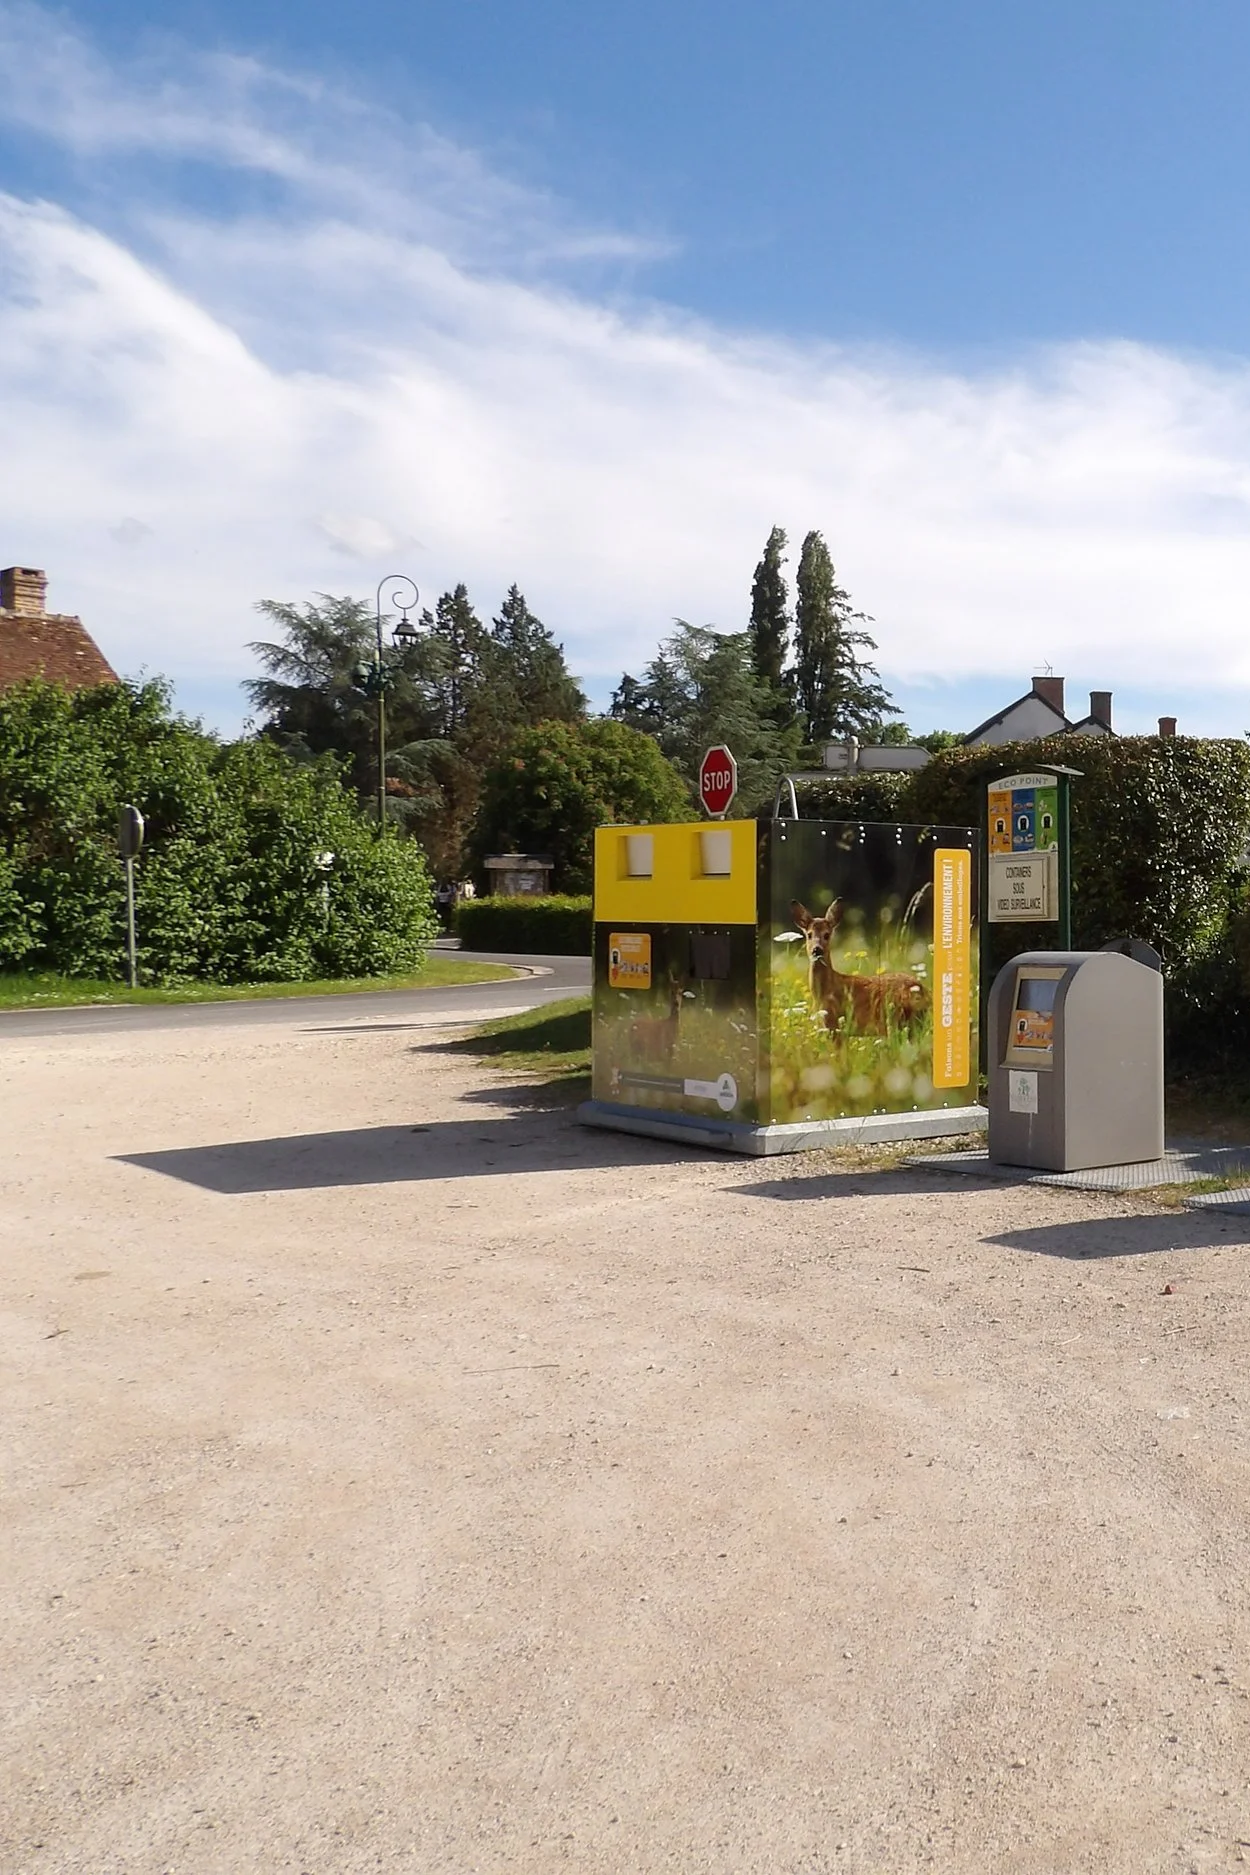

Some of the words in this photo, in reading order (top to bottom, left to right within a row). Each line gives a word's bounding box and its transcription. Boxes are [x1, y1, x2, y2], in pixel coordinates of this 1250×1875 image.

[704, 770, 731, 791] STOP
[998, 780, 1017, 789] ECO
[1020, 777, 1049, 786] POINT
[1006, 866, 1031, 878] CONTAINERS
[1013, 882, 1024, 894] SOUS
[942, 864, 953, 949] L'ENVIRONNEMENT
[1011, 897, 1041, 910] SURVEILLANCE
[942, 972, 953, 1027] GESTE
[944, 1042, 953, 1078] Faisons
